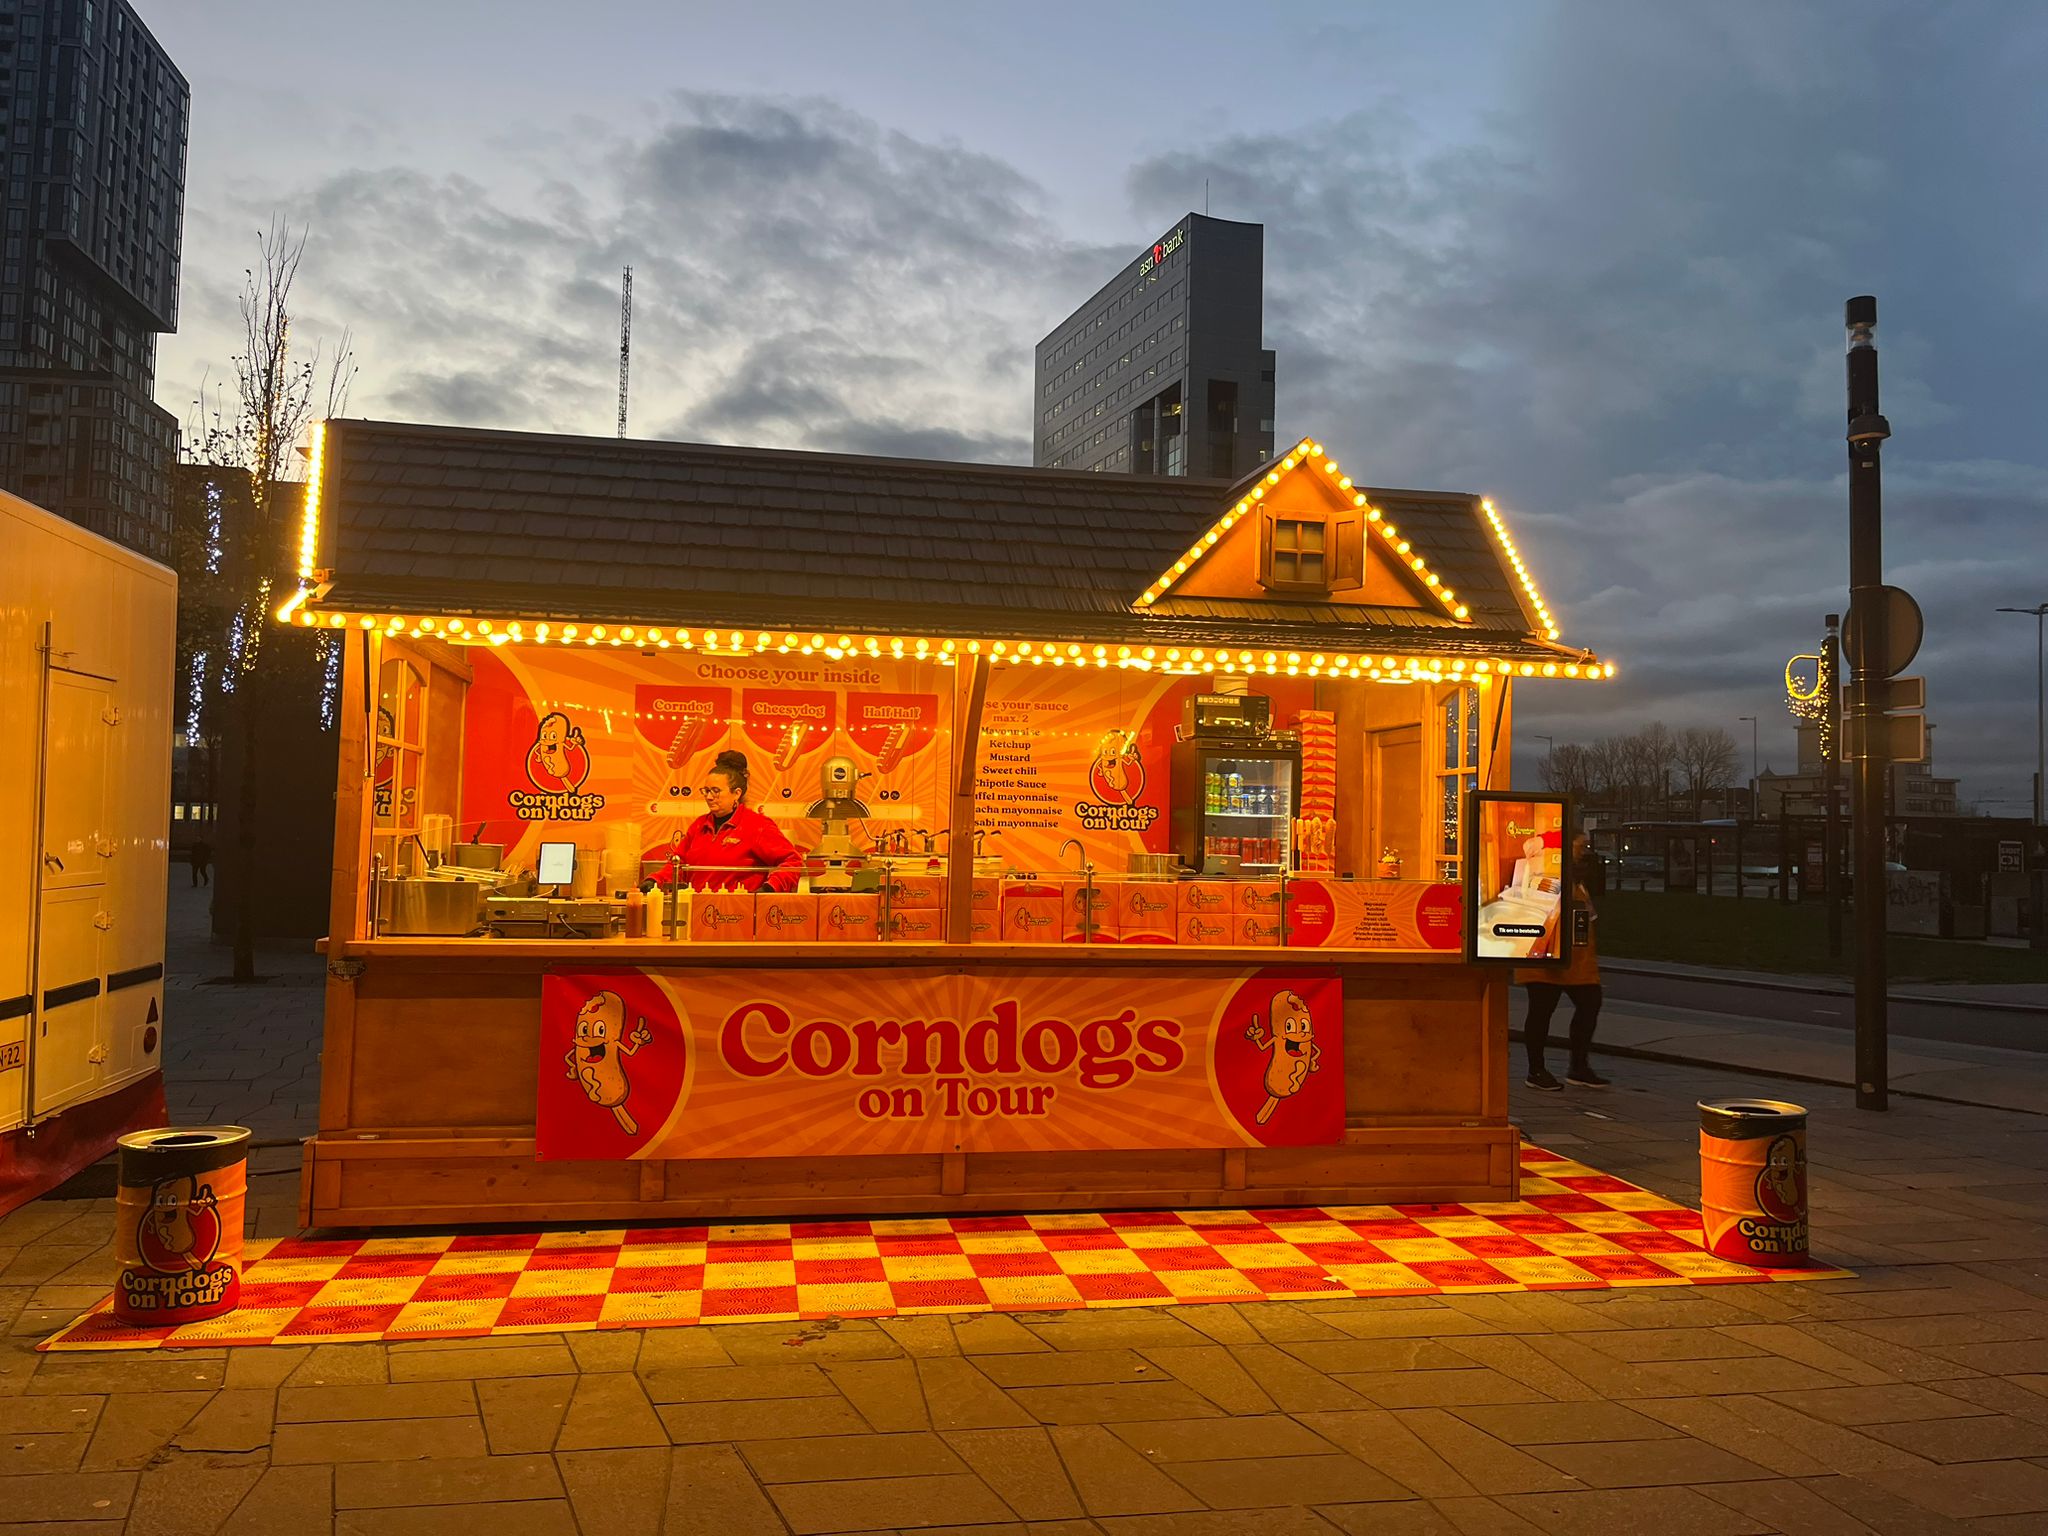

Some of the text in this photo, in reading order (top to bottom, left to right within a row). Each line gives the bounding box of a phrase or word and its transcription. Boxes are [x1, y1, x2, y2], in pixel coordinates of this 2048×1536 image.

[1140, 229, 1185, 275] asn bank
[697, 663, 881, 685] Choose your inside
[653, 699, 713, 714] Corndog
[752, 702, 826, 718] Cheesydog
[1002, 700, 1032, 712] your
[1033, 702, 1069, 712] sauce
[993, 714, 1029, 723] max. 2
[989, 740, 1031, 751] Ketchup
[989, 753, 1031, 762] Mustard
[982, 765, 1037, 775] Sweet chili
[1016, 779, 1047, 789] Sauce
[509, 791, 603, 810] Corndogs
[997, 793, 1059, 803] mayonnaise
[517, 804, 595, 820] on Tour
[975, 805, 1063, 816] acha mayonnaise
[1075, 802, 1158, 820] Corndogs
[974, 818, 1059, 829] sabi mayonnaise
[1083, 814, 1150, 830] on Tour
[721, 999, 1185, 1089] Corndogs
[857, 1077, 1055, 1118] on Tour
[1738, 1219, 1807, 1239] Corndo
[1750, 1236, 1809, 1252] on Tou
[121, 1264, 233, 1294] Corndogs
[128, 1283, 226, 1309] on Tour
